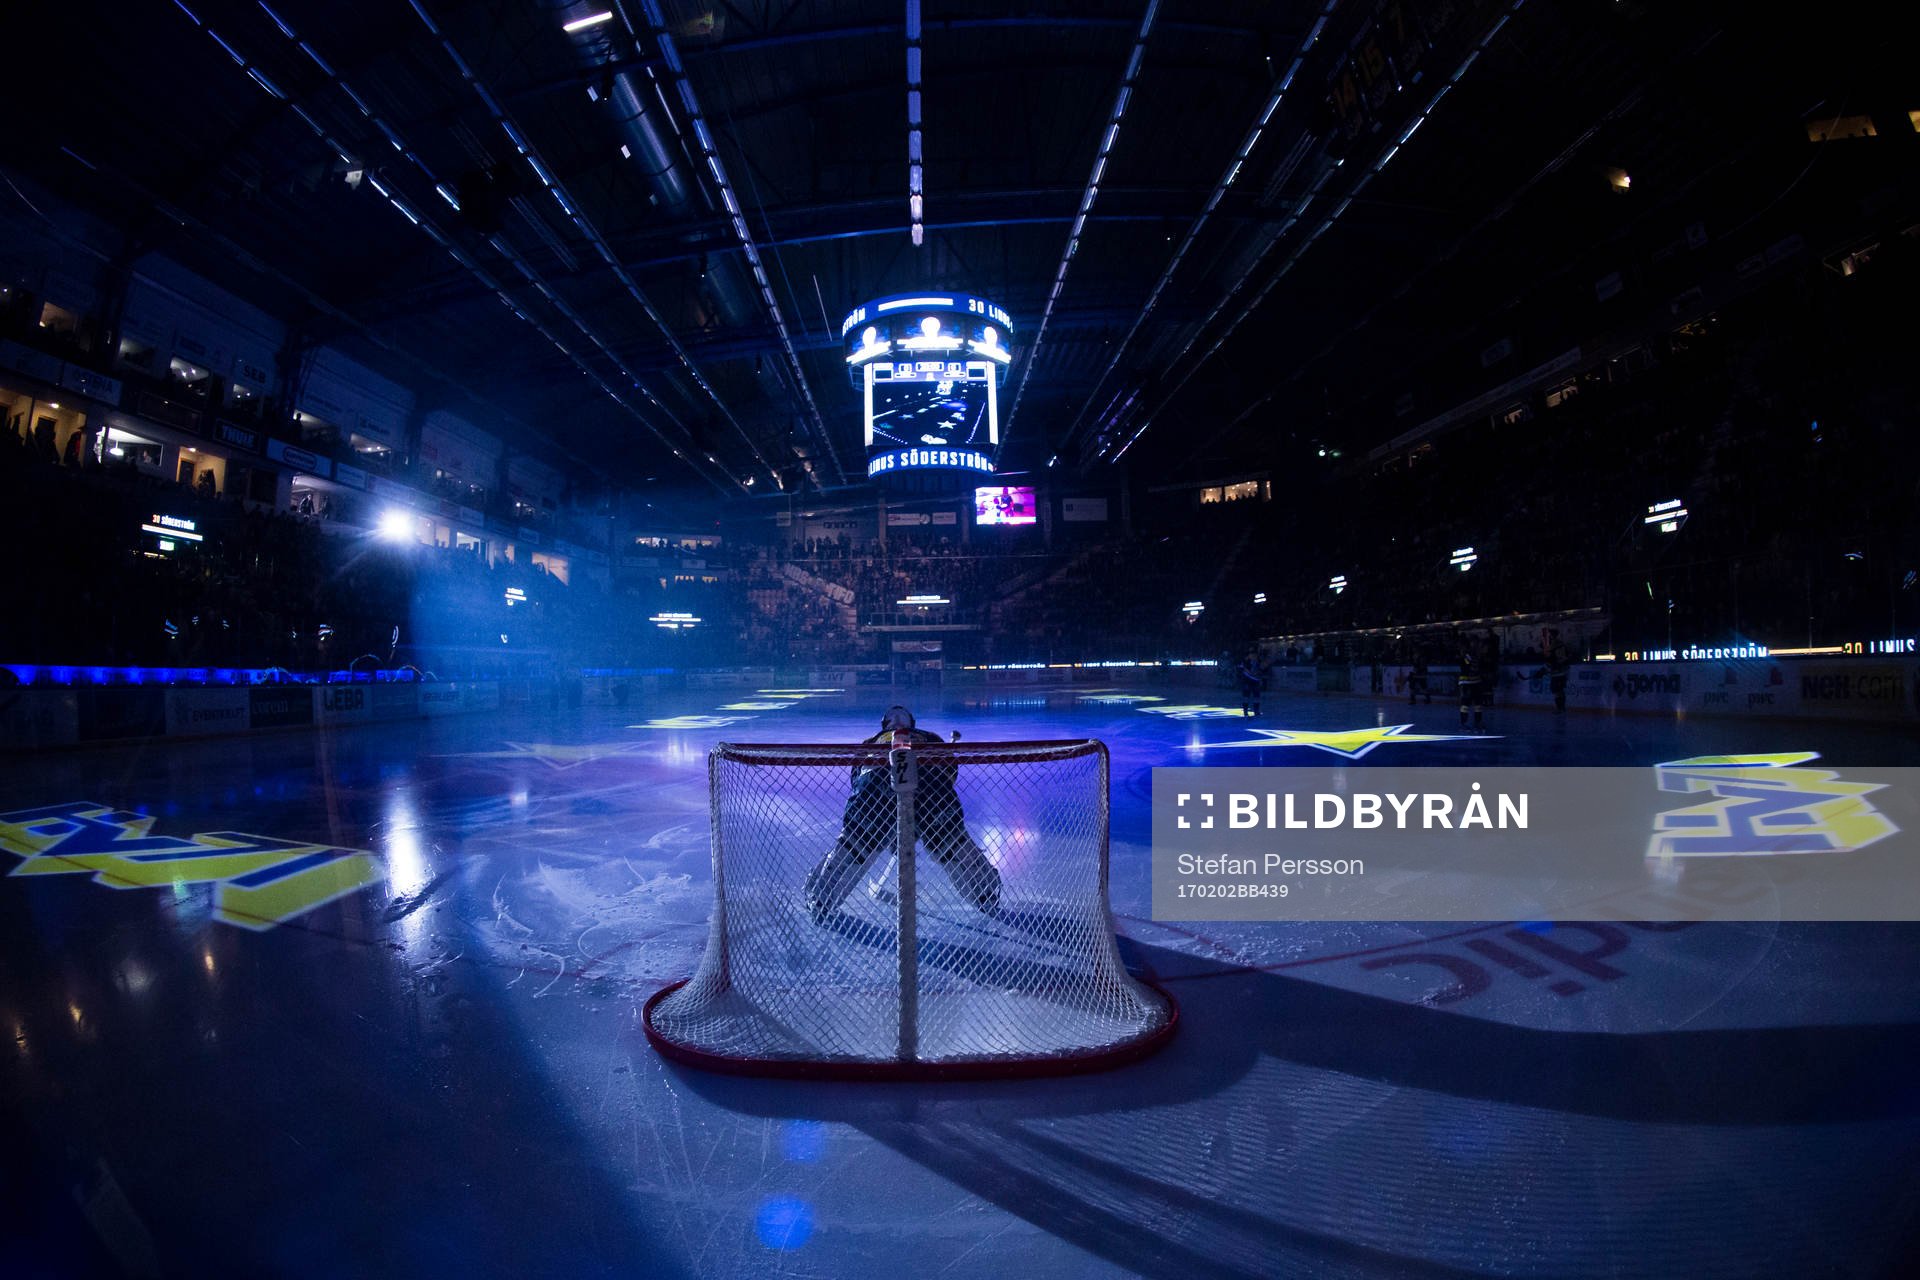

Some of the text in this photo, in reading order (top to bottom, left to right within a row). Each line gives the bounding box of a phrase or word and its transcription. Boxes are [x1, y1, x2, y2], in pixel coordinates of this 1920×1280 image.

[968, 298, 985, 314] 30
[869, 448, 988, 475] LINUS SÖDERSTRÖM
[895, 751, 909, 785] SHL
